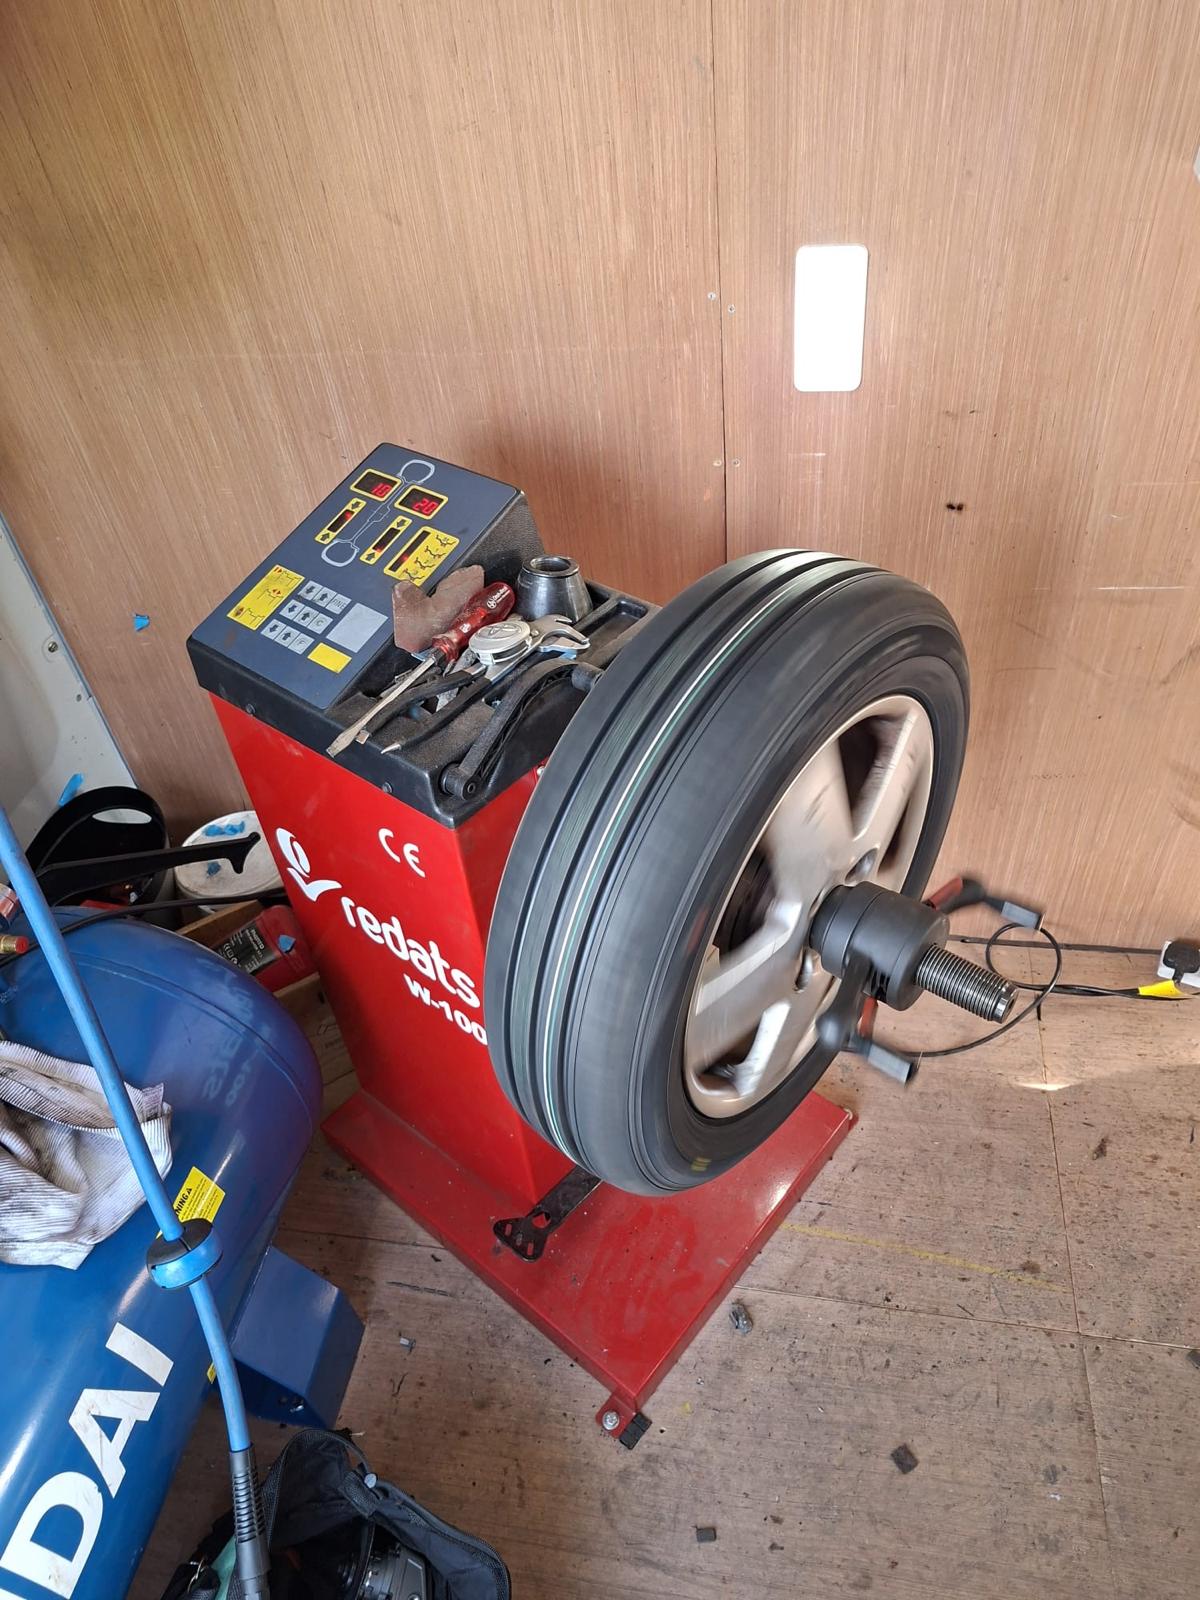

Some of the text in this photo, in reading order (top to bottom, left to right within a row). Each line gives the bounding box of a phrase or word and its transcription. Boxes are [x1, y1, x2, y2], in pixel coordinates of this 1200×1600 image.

[412, 498, 438, 515] 20
[378, 828, 425, 878] CE
[341, 897, 480, 1008] redats
[403, 973, 488, 1046] W-100
[174, 1193, 189, 1216] NING
[0, 1322, 174, 1600] DAI
